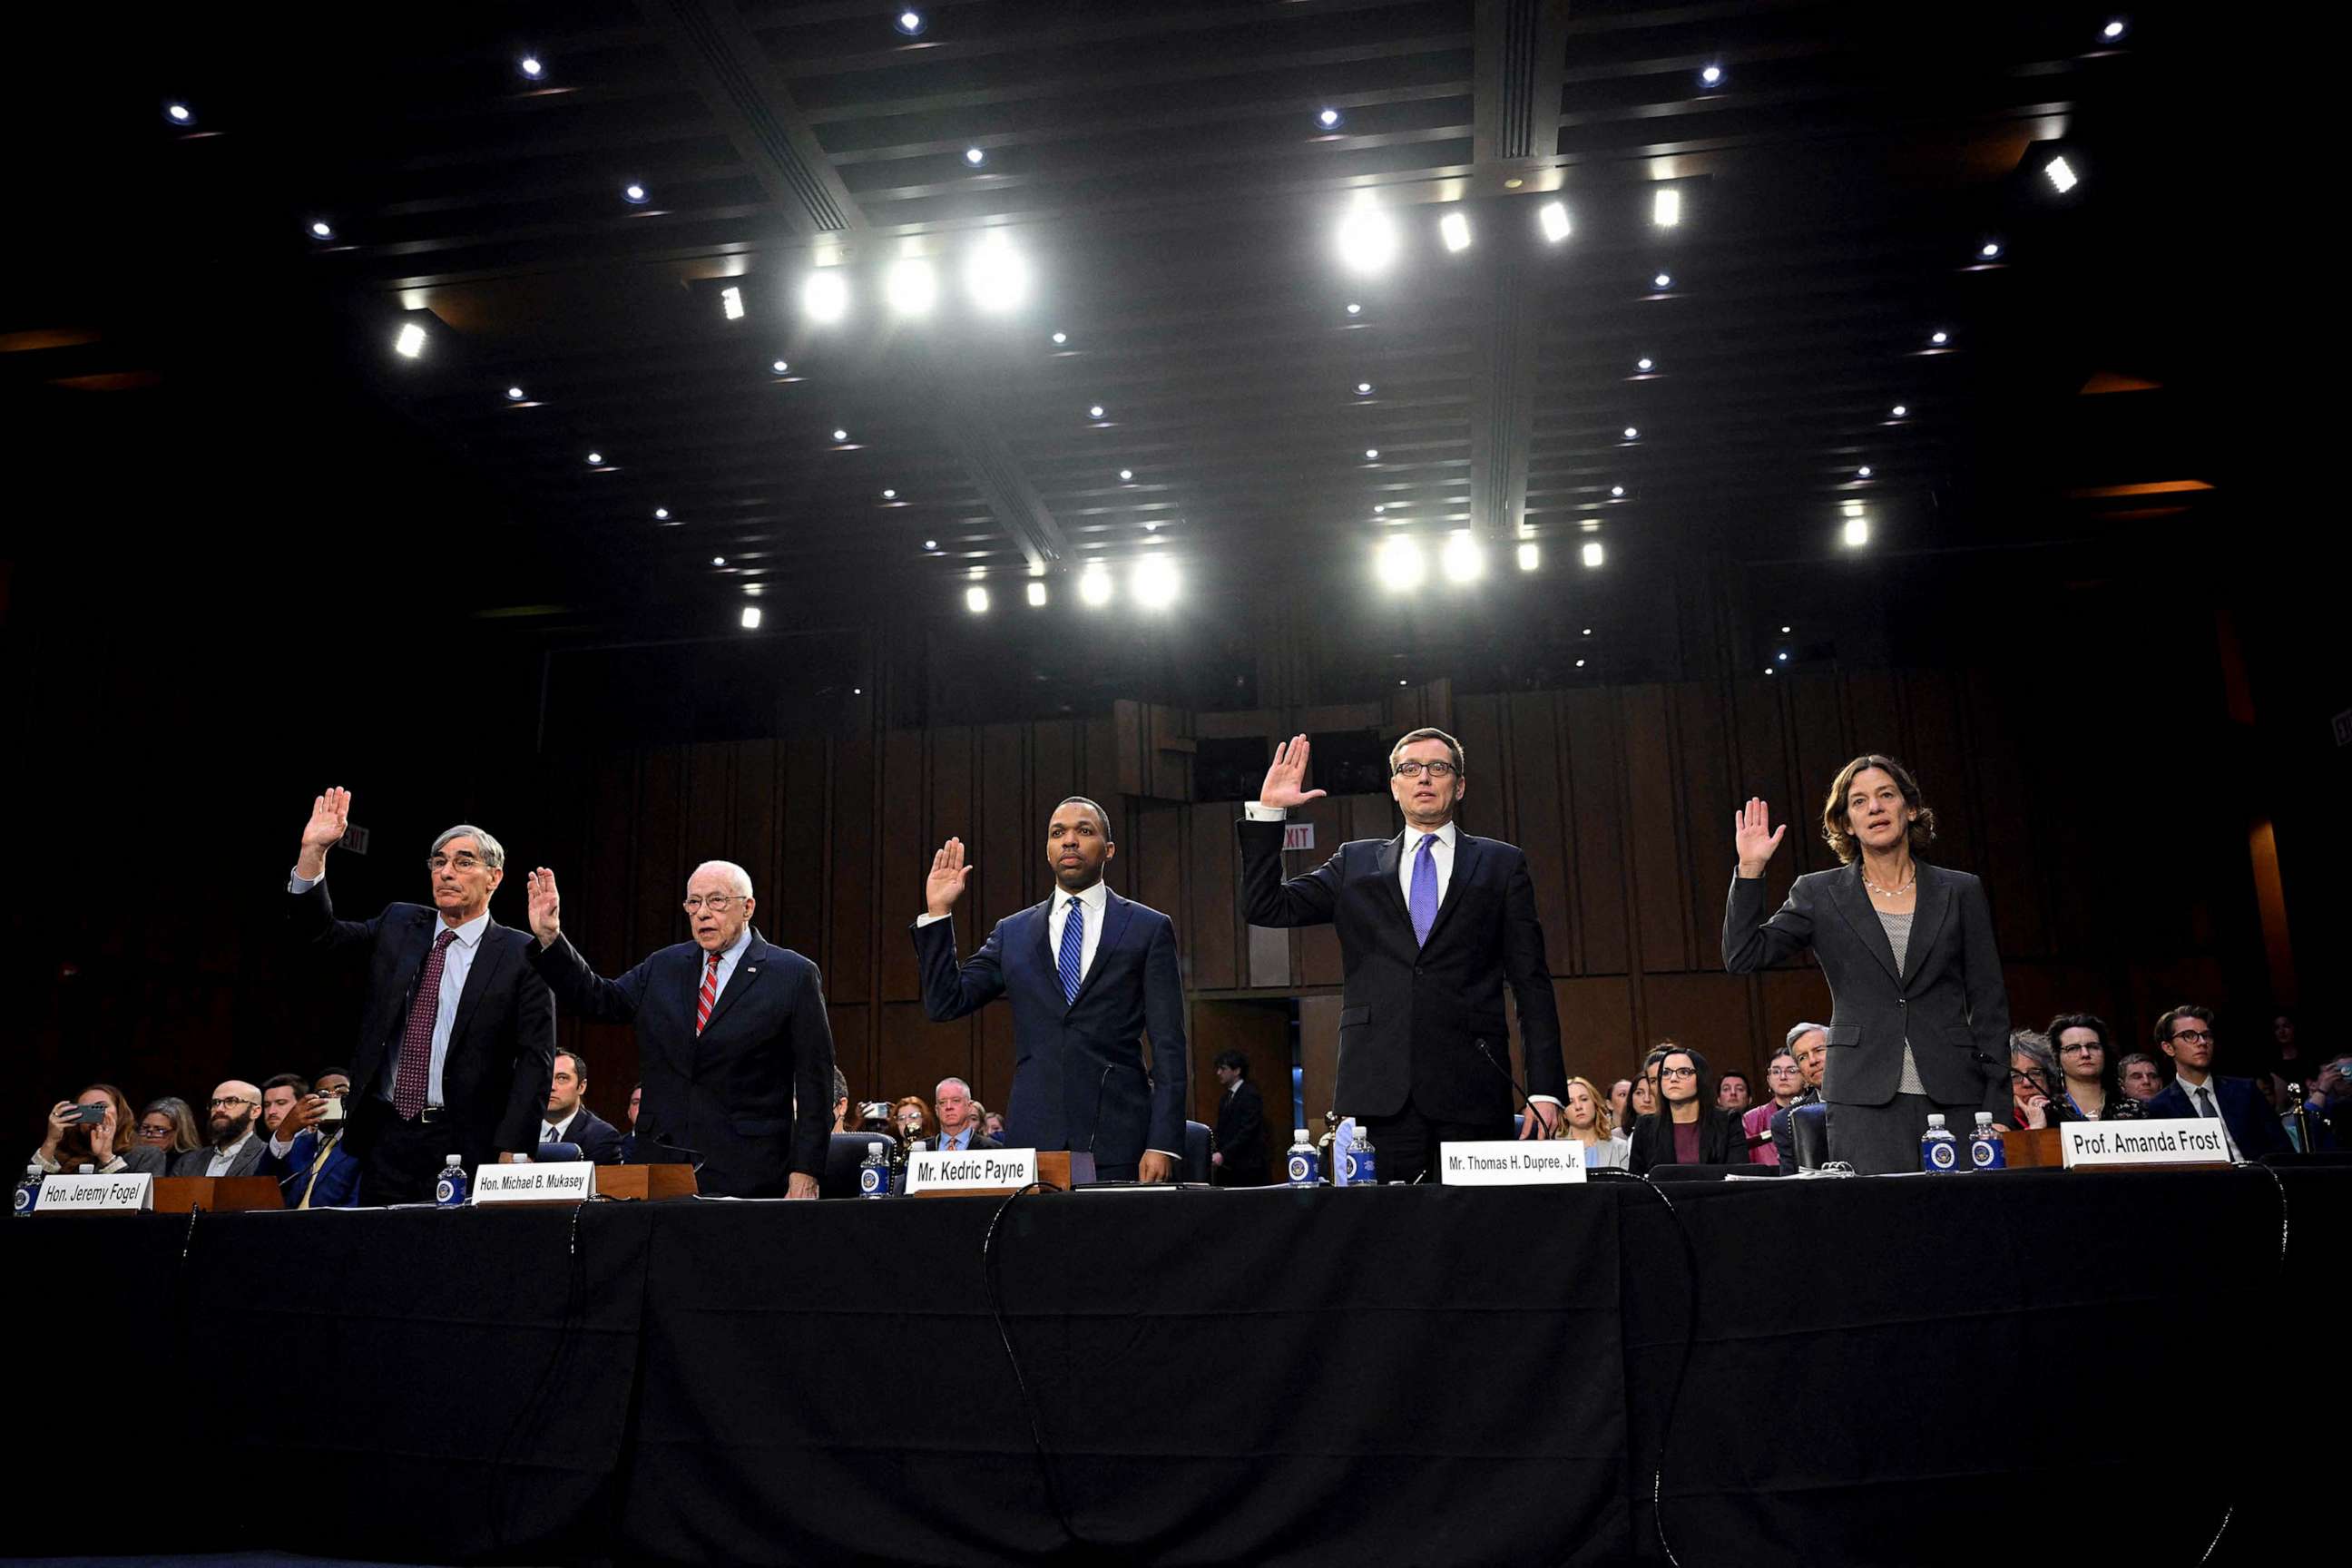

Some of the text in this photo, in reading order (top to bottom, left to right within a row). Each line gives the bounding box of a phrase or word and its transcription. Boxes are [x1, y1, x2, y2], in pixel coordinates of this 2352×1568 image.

[1286, 828, 1308, 848] XIT
[2073, 1130, 2220, 1155] Prof. Amanda Frost
[917, 1159, 1024, 1183] Mr. Kedric Payne
[1449, 1153, 1579, 1171] Mr. Thomas H. Dupree, Jr.
[480, 1173, 584, 1191] Hon. Michael B. Mukasey
[44, 1182, 141, 1205] Hon. Jeremy Fogel
